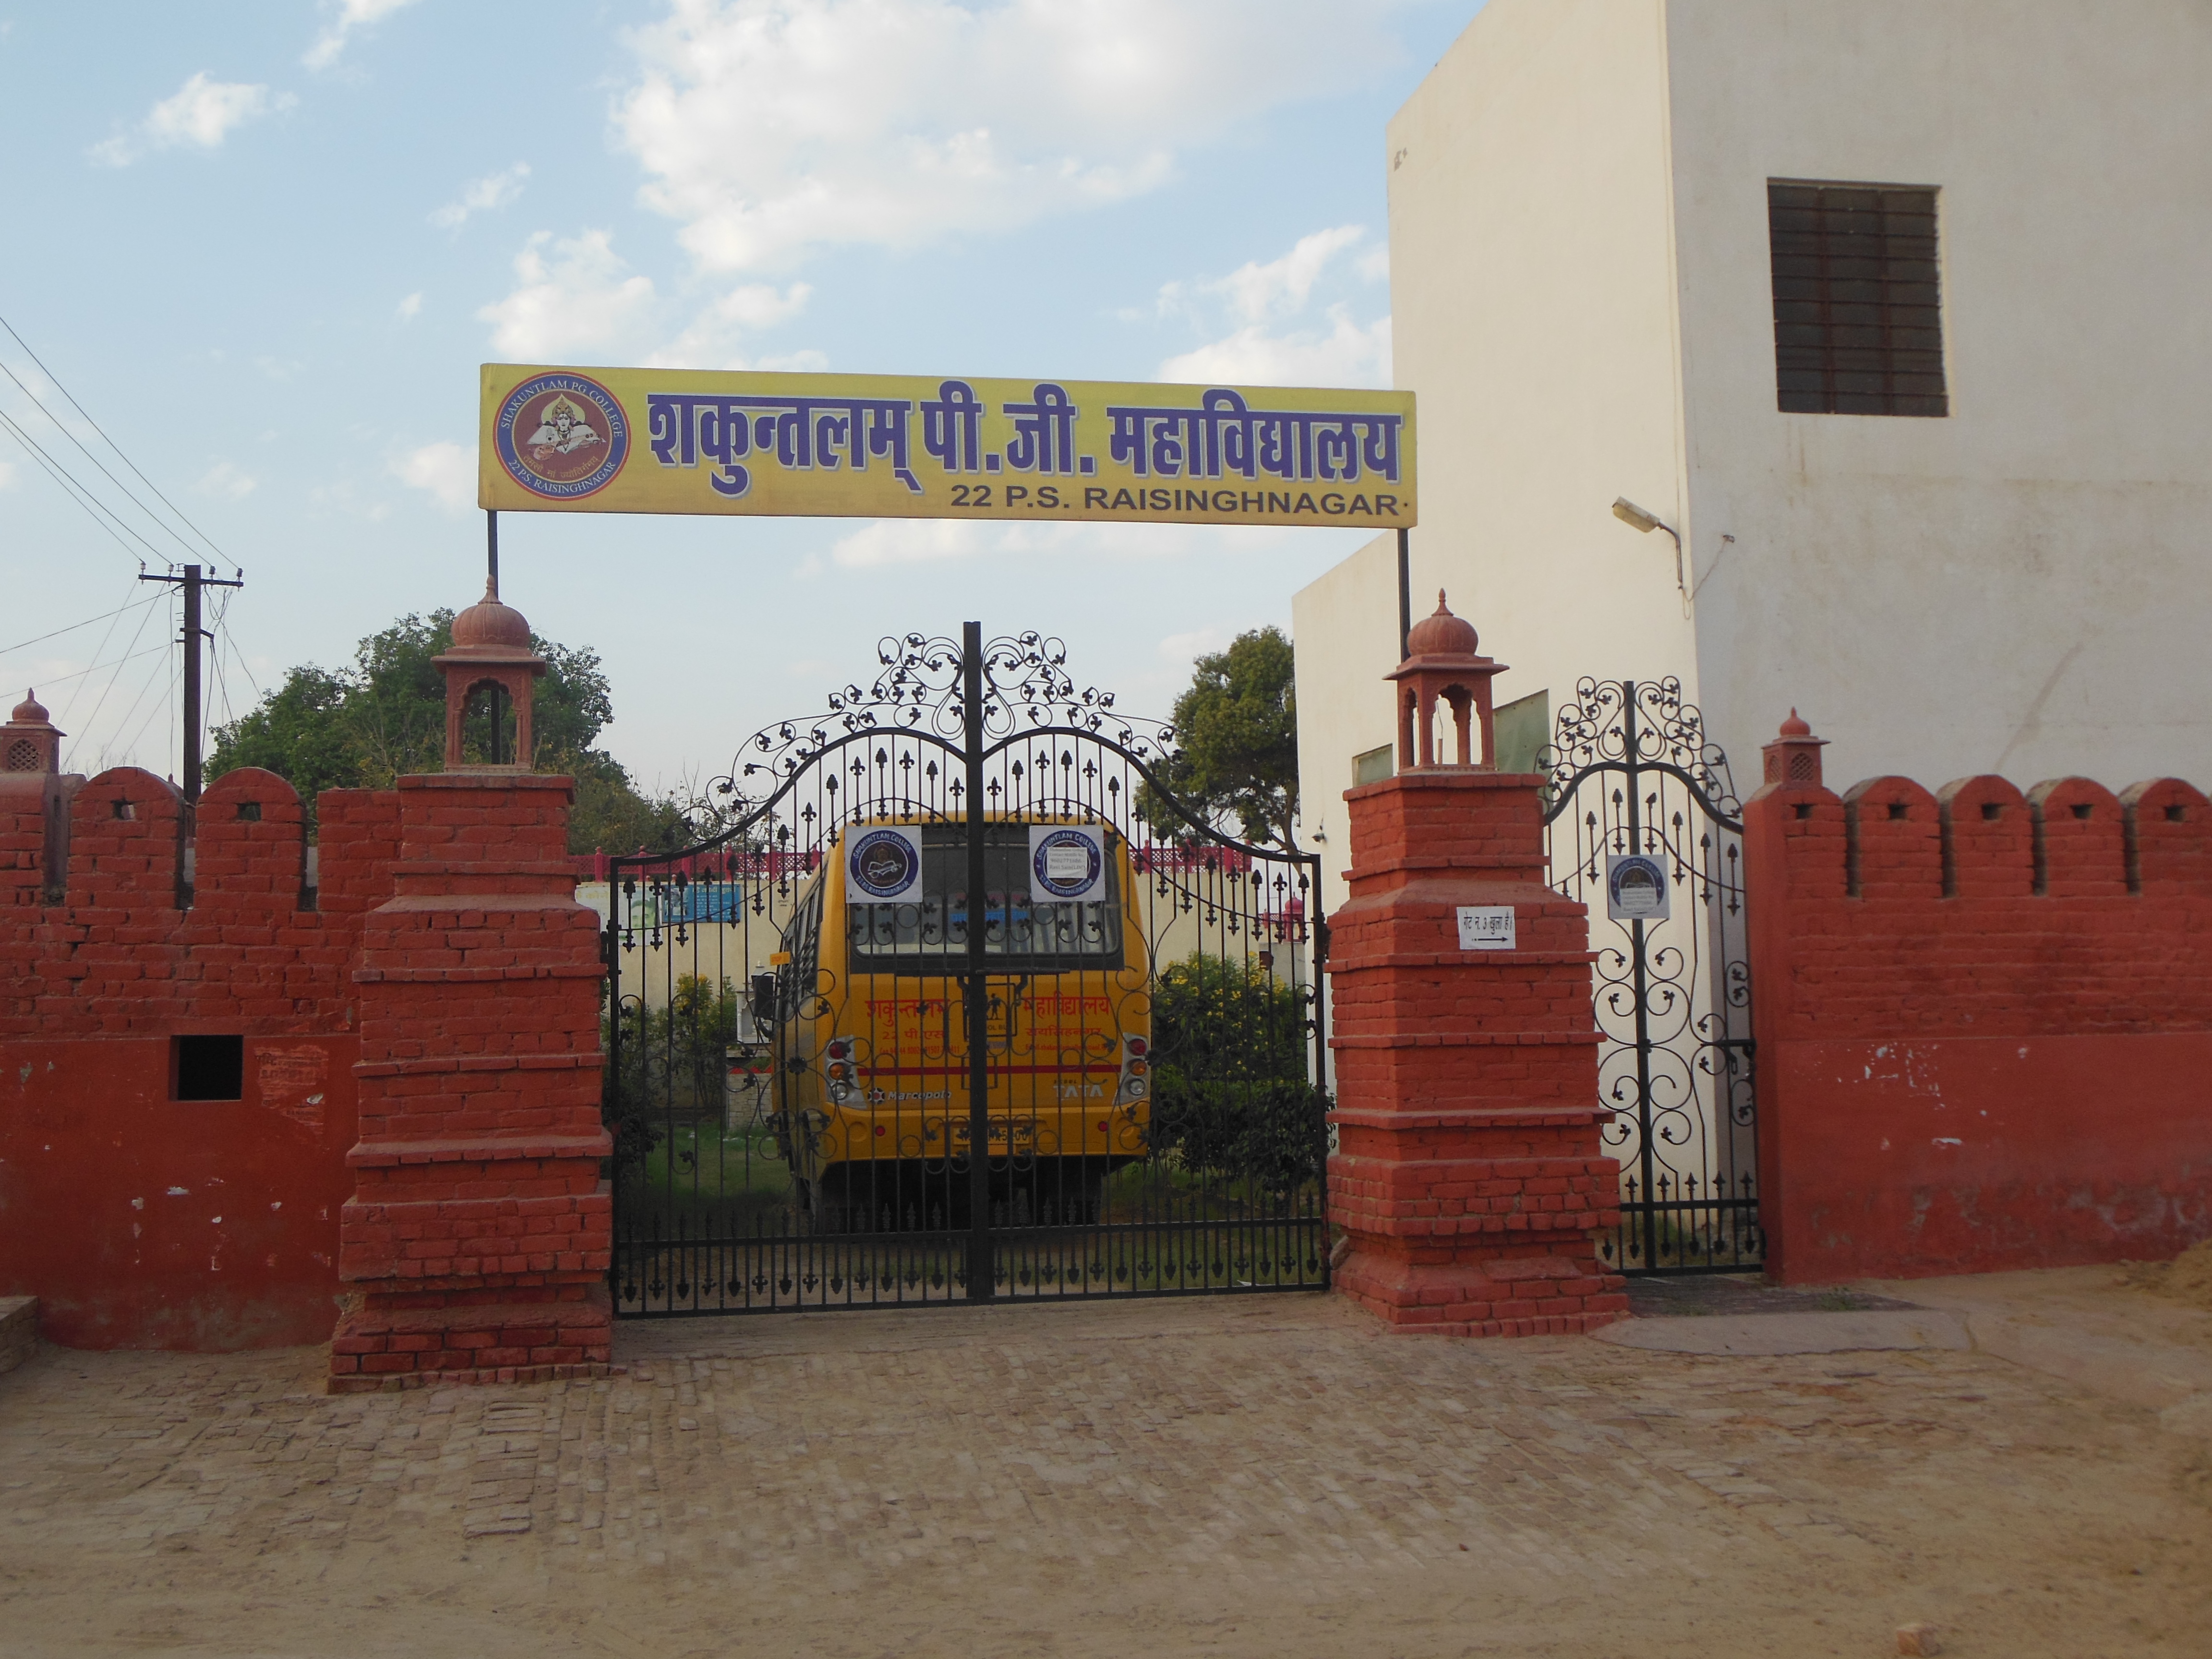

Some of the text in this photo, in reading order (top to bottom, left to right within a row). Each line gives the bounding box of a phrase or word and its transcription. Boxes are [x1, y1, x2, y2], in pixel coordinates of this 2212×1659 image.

[501, 380, 623, 437] SHAKUNTLAM PG COLLEGE
[648, 393, 922, 495] शकुन्तलम्
[1107, 389, 1403, 482] महाविद्यालय
[508, 459, 520, 470] 22
[534, 461, 616, 493] RAISINGHNAGAR
[950, 485, 992, 507] 22
[1006, 486, 1070, 509] P.S.
[1464, 911, 1472, 930] गेट
[1490, 916, 1503, 935] खुला
[1053, 1084, 1103, 1097] TATA
